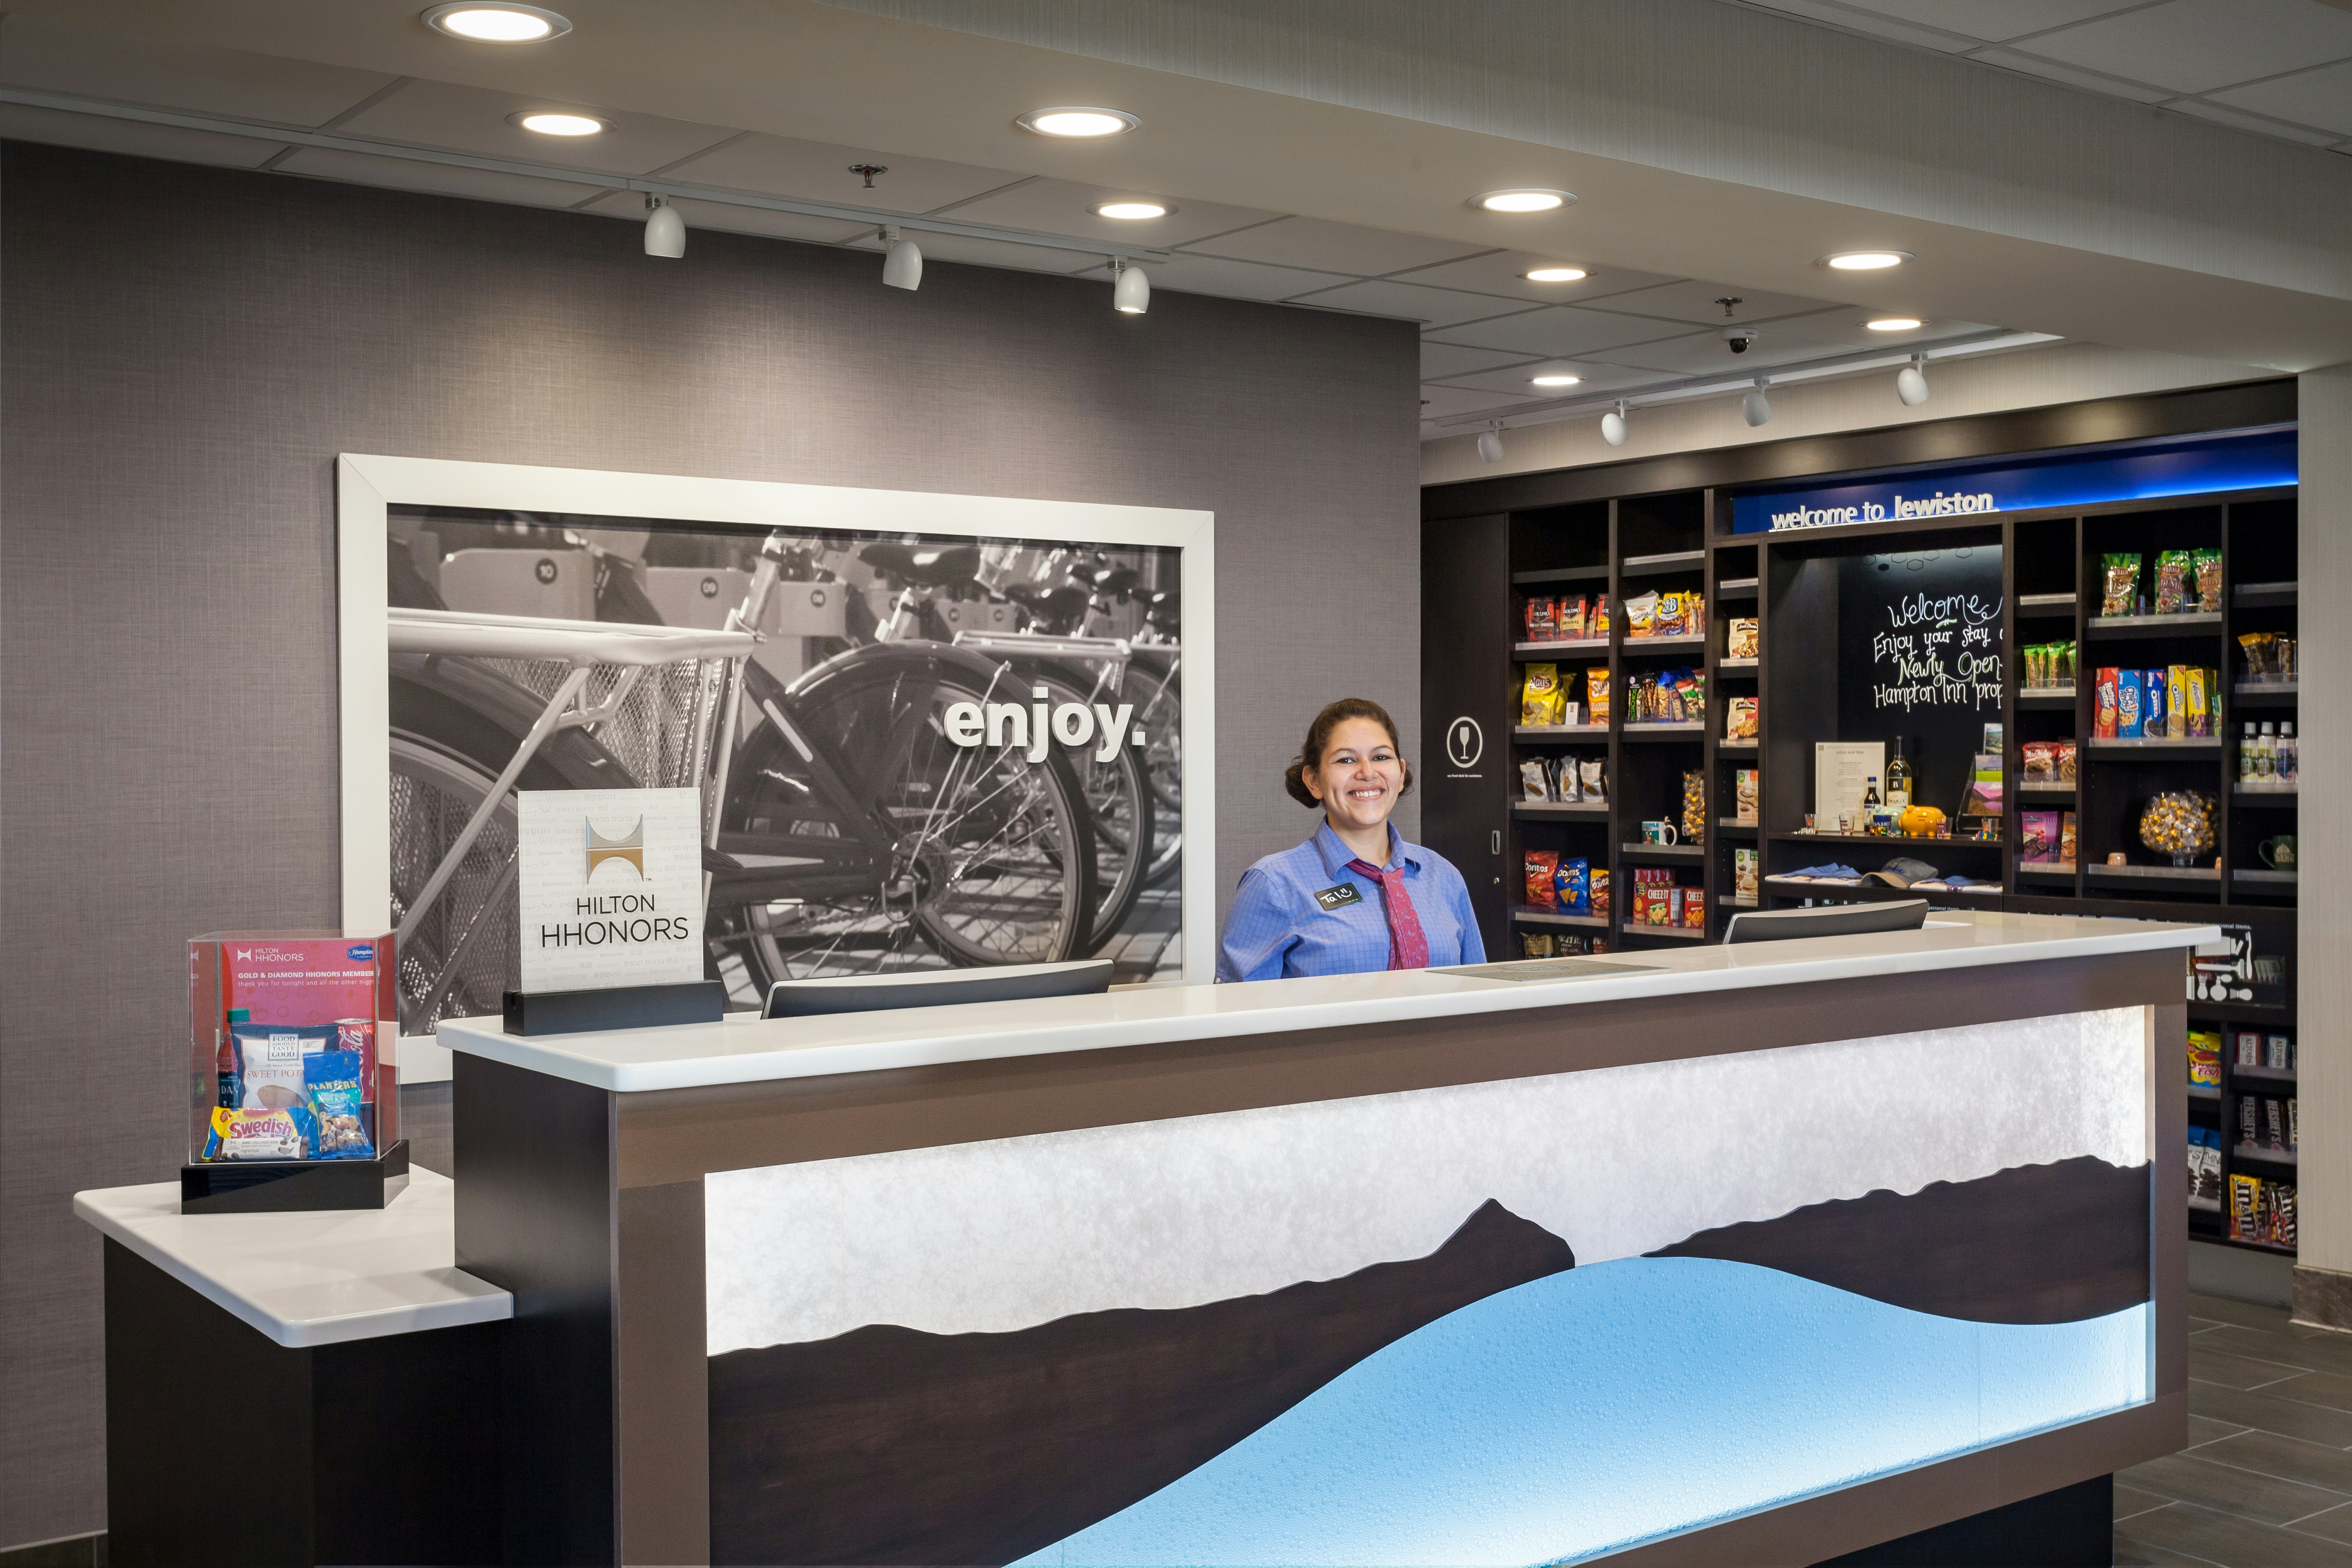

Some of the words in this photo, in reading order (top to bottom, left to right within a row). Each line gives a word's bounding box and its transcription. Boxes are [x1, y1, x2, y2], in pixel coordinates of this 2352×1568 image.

[1772, 505, 1857, 529] welcome
[1862, 501, 1885, 521] to
[1895, 492, 1993, 518] lewiston
[1888, 592, 1990, 628] Welcome
[1873, 632, 1918, 663] Enjoy
[1924, 628, 1953, 655] your
[1962, 624, 1991, 647] stay
[1898, 652, 1945, 686] Newly
[1958, 651, 2003, 688] Open
[1873, 681, 1937, 712] Hampton
[1942, 676, 1968, 704] Inn
[2098, 685, 2110, 709] Butter
[2104, 681, 2115, 706] Nutter
[2125, 686, 2136, 706] Chips
[2191, 681, 2201, 710] Newtons
[944, 686, 1145, 763] enjoy.
[1525, 862, 1548, 872] Doritos
[576, 894, 655, 916] HILTON
[542, 916, 689, 948] HHONORS
[255, 954, 304, 962] HHONORS
[247, 1070, 279, 1079] SWEET
[281, 1069, 304, 1078] POTA
[307, 1080, 357, 1093] PLANTERS
[229, 1117, 293, 1139] Swedish
[2204, 1152, 2220, 1165] THIN
